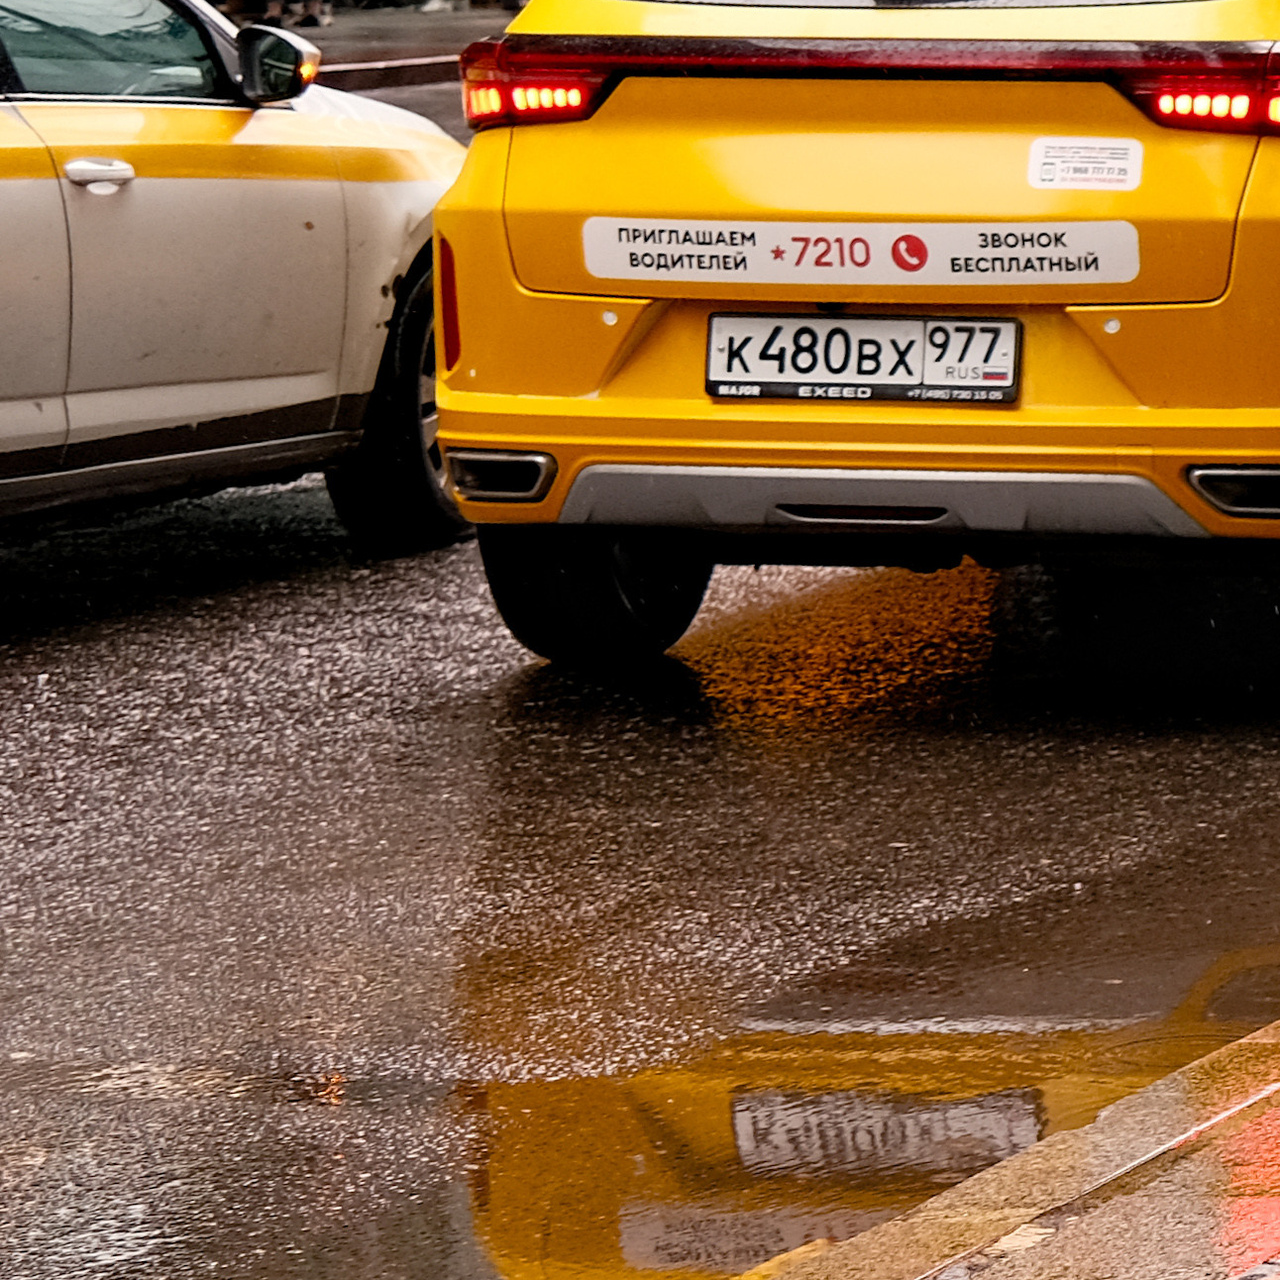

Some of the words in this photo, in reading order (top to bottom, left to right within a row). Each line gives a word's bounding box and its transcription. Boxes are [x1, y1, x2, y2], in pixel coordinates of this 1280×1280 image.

[618, 227, 757, 247] ПРИГЛАШАЕМ
[978, 232, 1068, 249] ЗВОНОК
[629, 251, 748, 271] ВОДИТЕЛЕЙ
[951, 252, 1100, 273] БЕСПЛАТНЫЙ
[929, 326, 1001, 364] 977
[945, 365, 980, 380] RUS
[718, 384, 761, 397] MAJOR
[798, 385, 872, 398] EXEED
